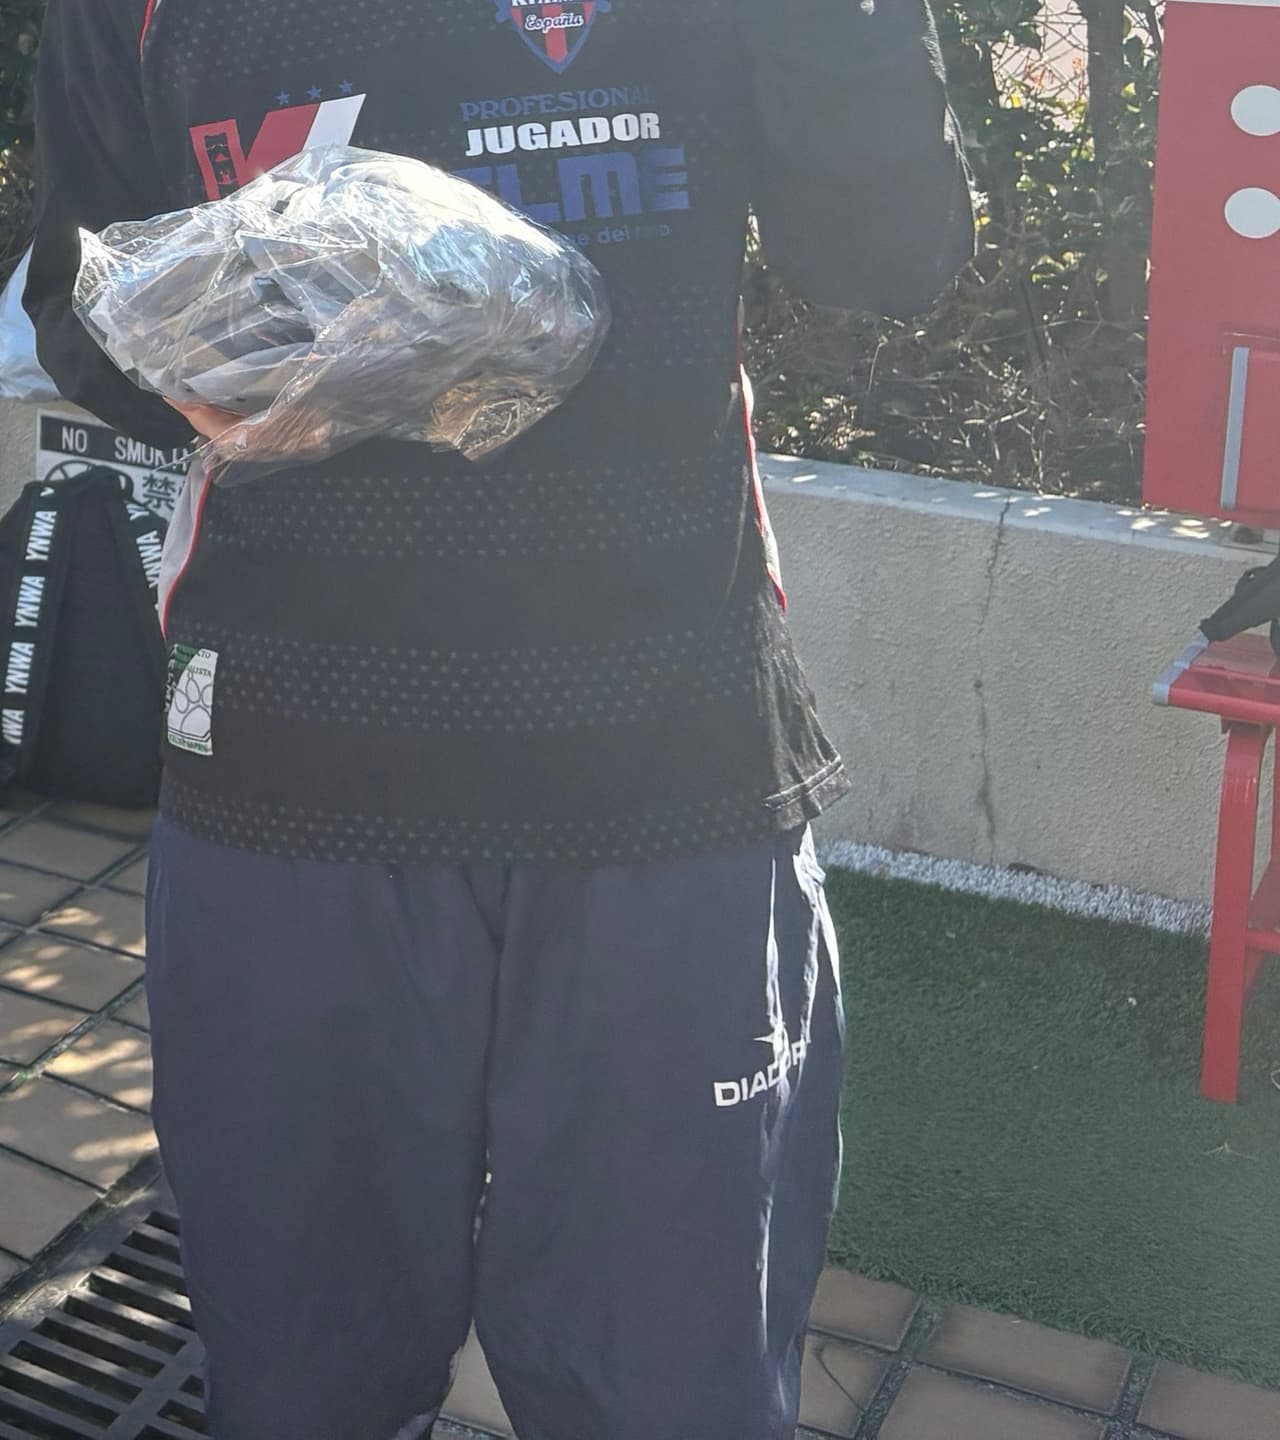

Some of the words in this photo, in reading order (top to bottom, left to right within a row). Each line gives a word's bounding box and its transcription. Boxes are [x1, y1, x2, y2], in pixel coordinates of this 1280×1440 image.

[525, 12, 584, 34] España
[459, 87, 655, 122] PROFESIONAL
[464, 112, 660, 157] JUGADOR
[61, 425, 88, 453] NO
[142, 473, 185, 511] 禁
[26, 511, 57, 560] YNWA
[15, 575, 45, 627] YNWA
[4, 642, 35, 694] YNWA
